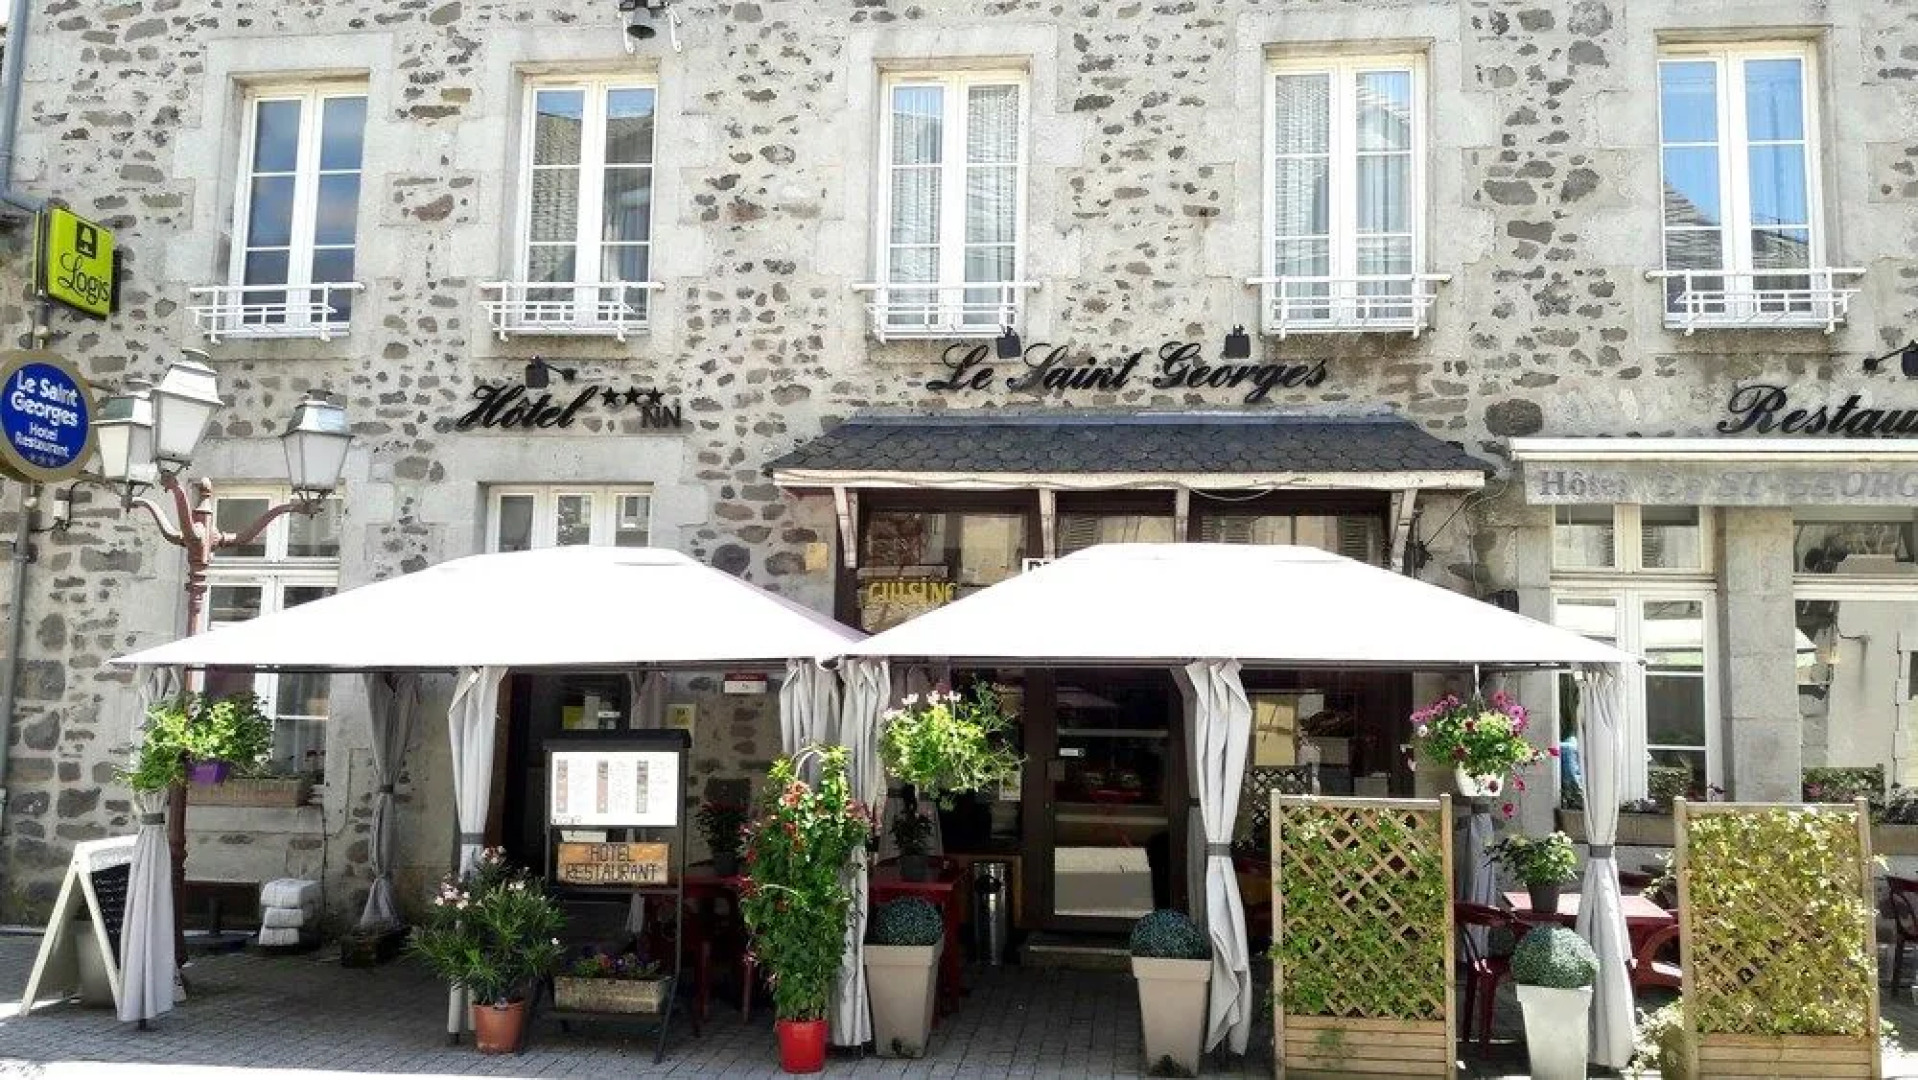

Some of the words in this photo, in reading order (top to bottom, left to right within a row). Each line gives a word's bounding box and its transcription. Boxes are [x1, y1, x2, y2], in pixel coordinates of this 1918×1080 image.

[57, 251, 110, 306] Logis
[16, 369, 37, 394] Le
[39, 377, 78, 408] Saint
[925, 342, 995, 391] Le
[1006, 342, 1143, 391] Saint
[1152, 341, 1328, 403] Georges
[11, 390, 78, 427] Georges
[454, 384, 600, 431] Hôtel
[641, 403, 682, 428] NN
[590, 843, 635, 862] HOTEL
